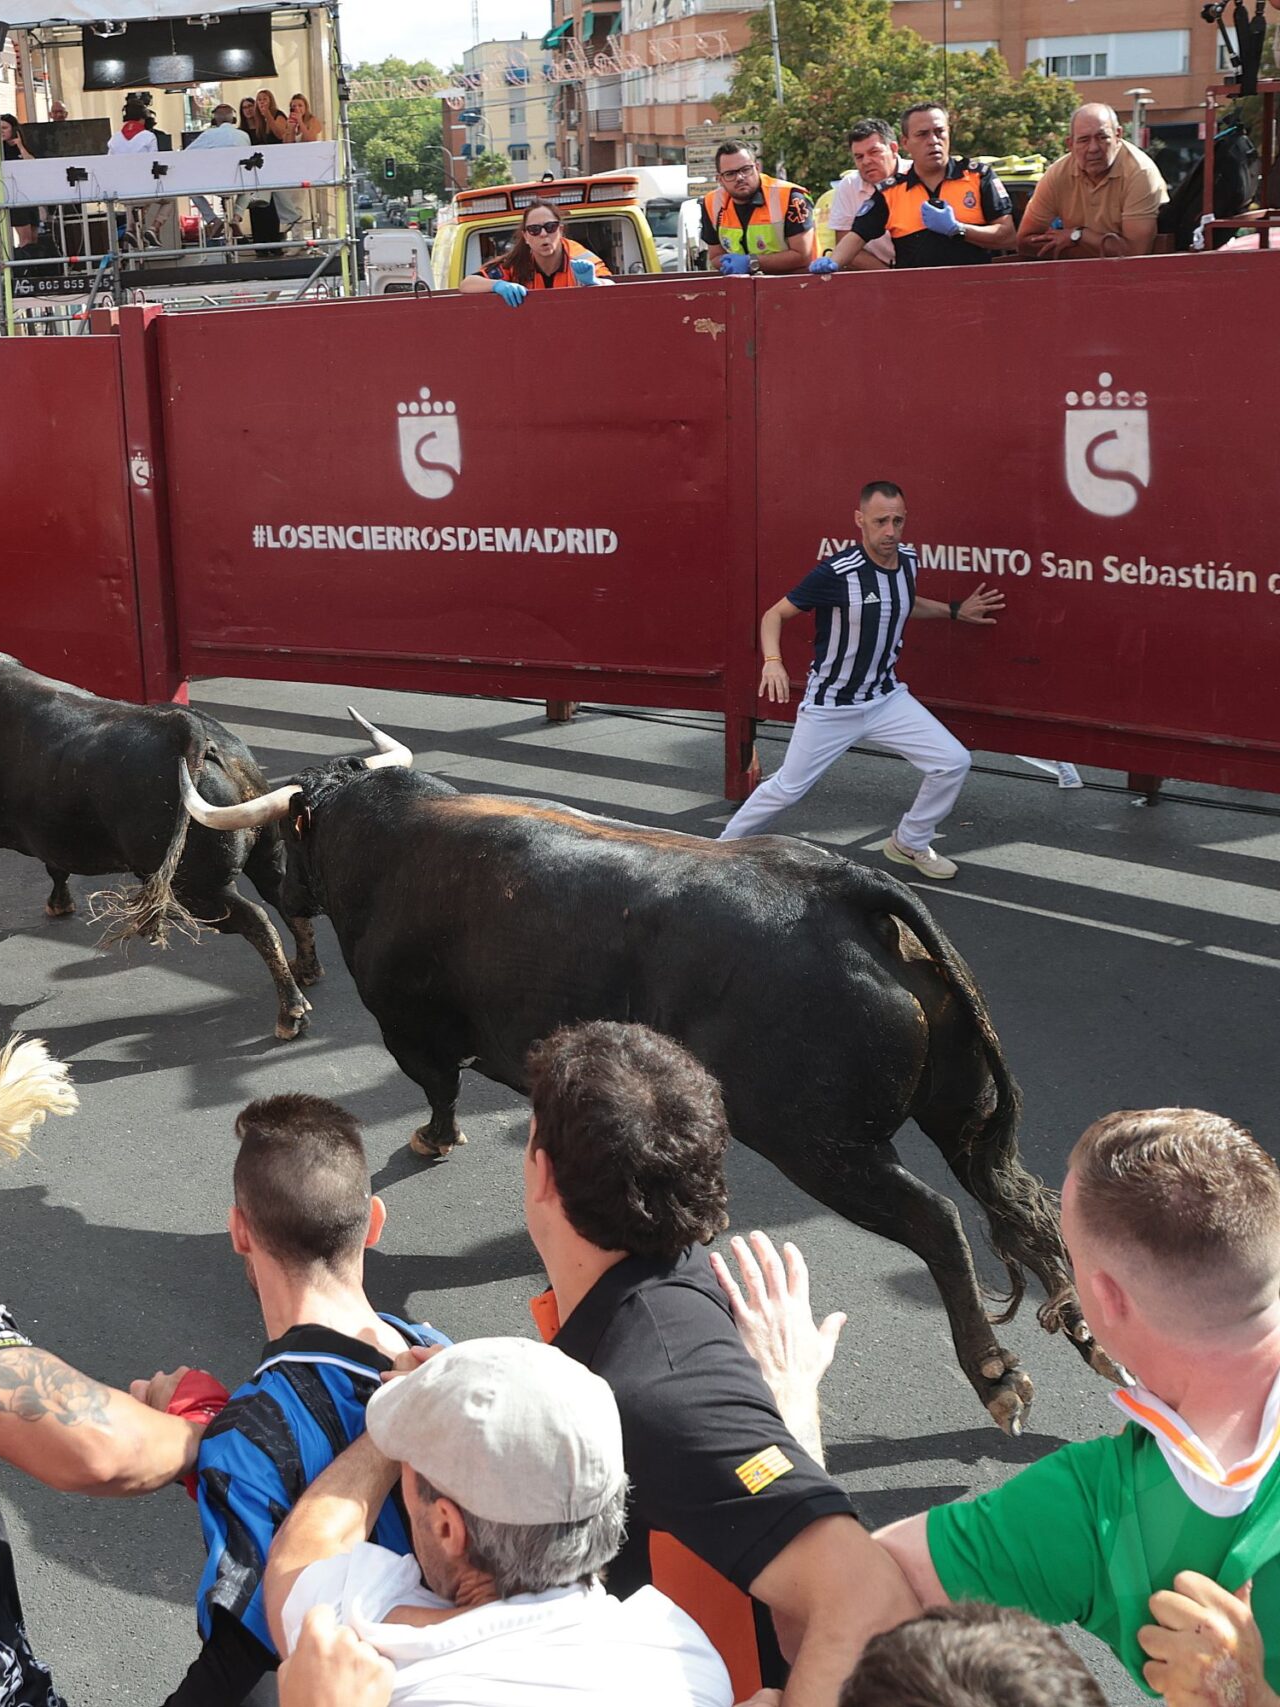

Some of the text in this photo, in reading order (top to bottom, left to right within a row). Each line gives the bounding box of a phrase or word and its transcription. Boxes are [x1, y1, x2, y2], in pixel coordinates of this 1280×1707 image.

[252, 525, 619, 554] #LOSENCIERROSDEMADRID
[816, 537, 1030, 577] AYMIENTO
[1040, 551, 1094, 581] San
[1102, 555, 1258, 593] Sebastián
